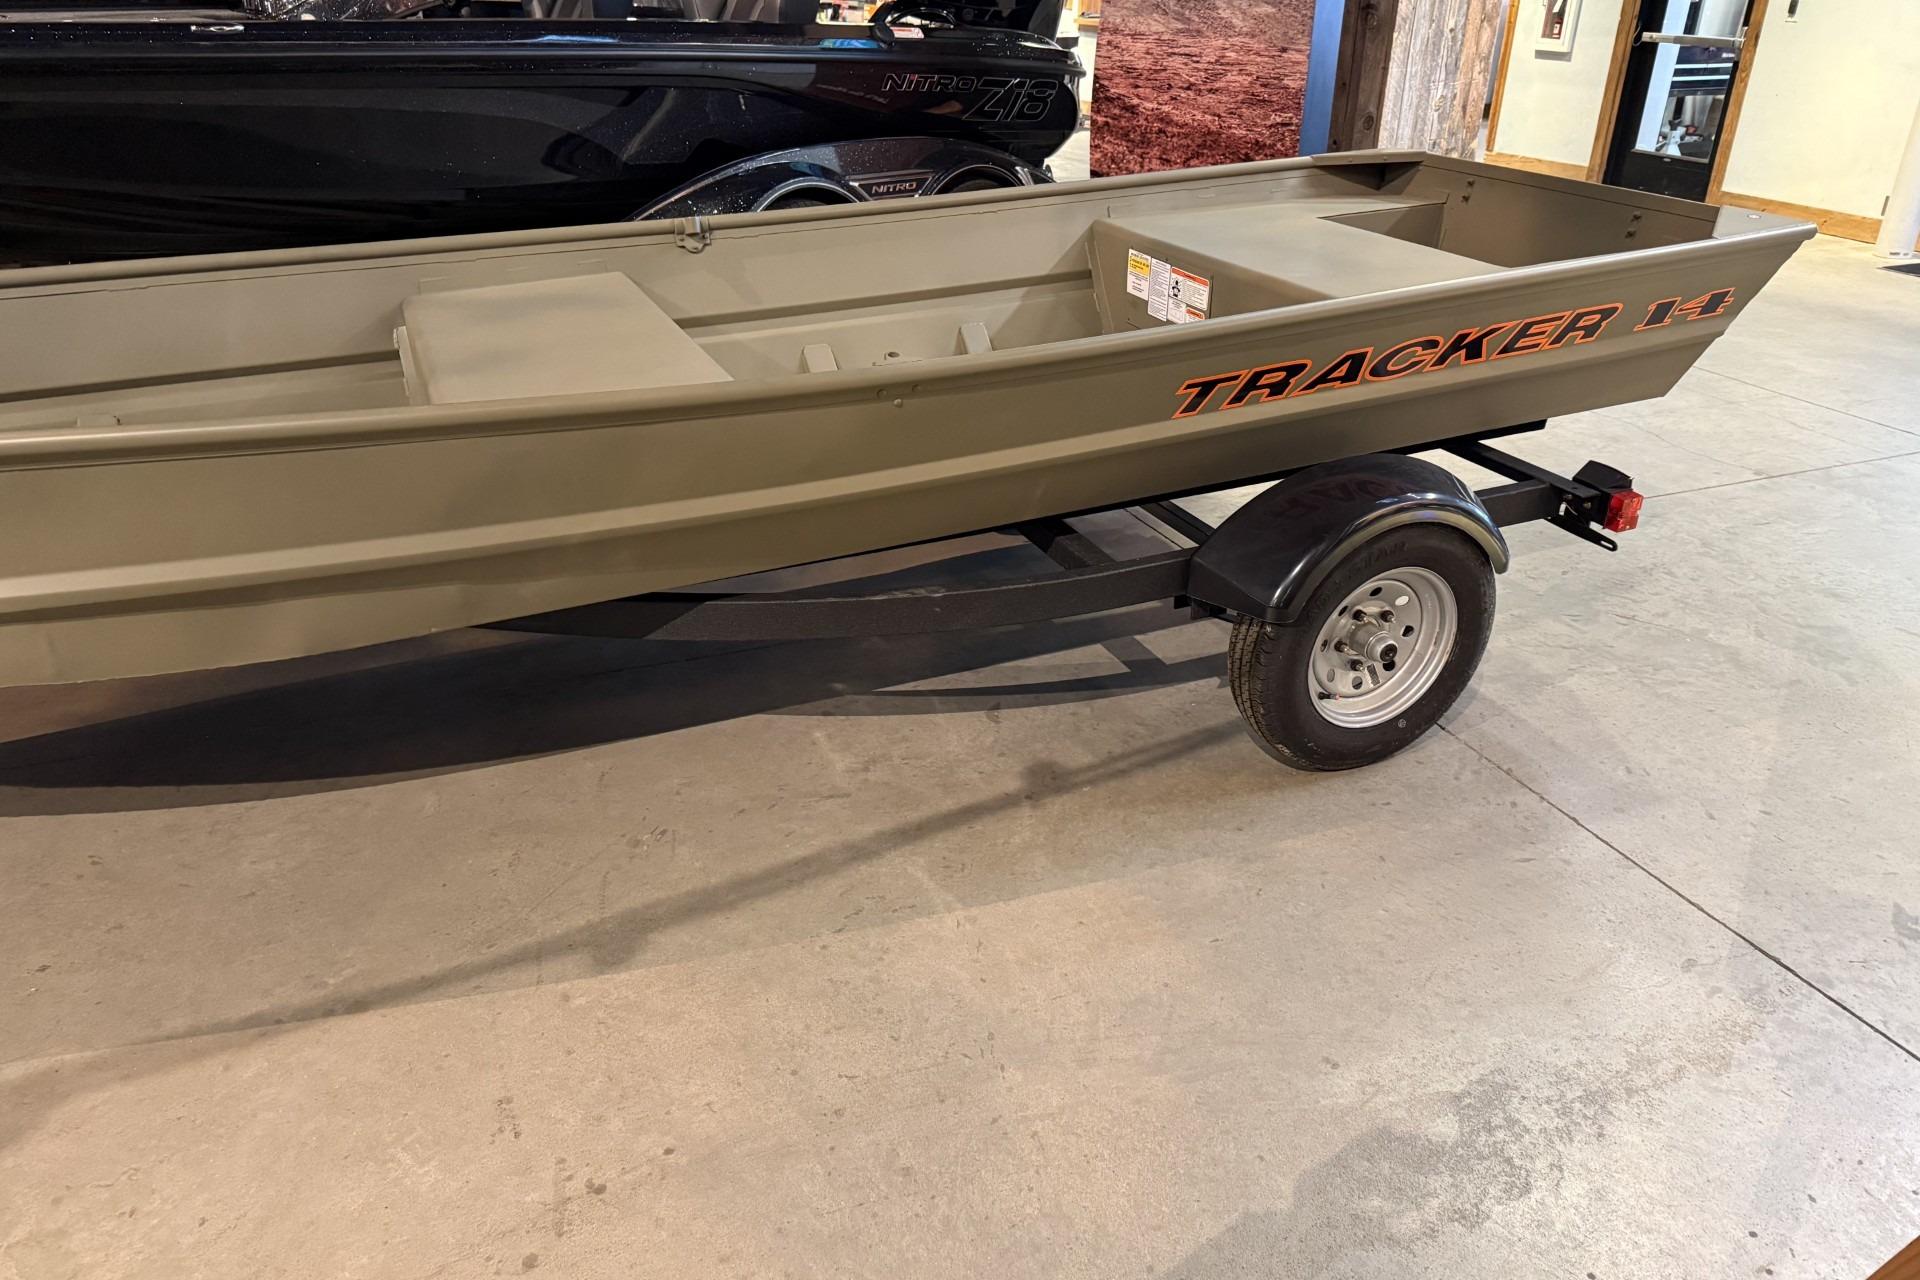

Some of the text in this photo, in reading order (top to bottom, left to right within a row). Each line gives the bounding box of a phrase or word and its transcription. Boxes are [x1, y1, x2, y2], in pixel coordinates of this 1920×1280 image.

[962, 77, 1058, 122] Z18
[872, 181, 917, 194] NITRO
[1172, 288, 1736, 419] TRACKER 14
